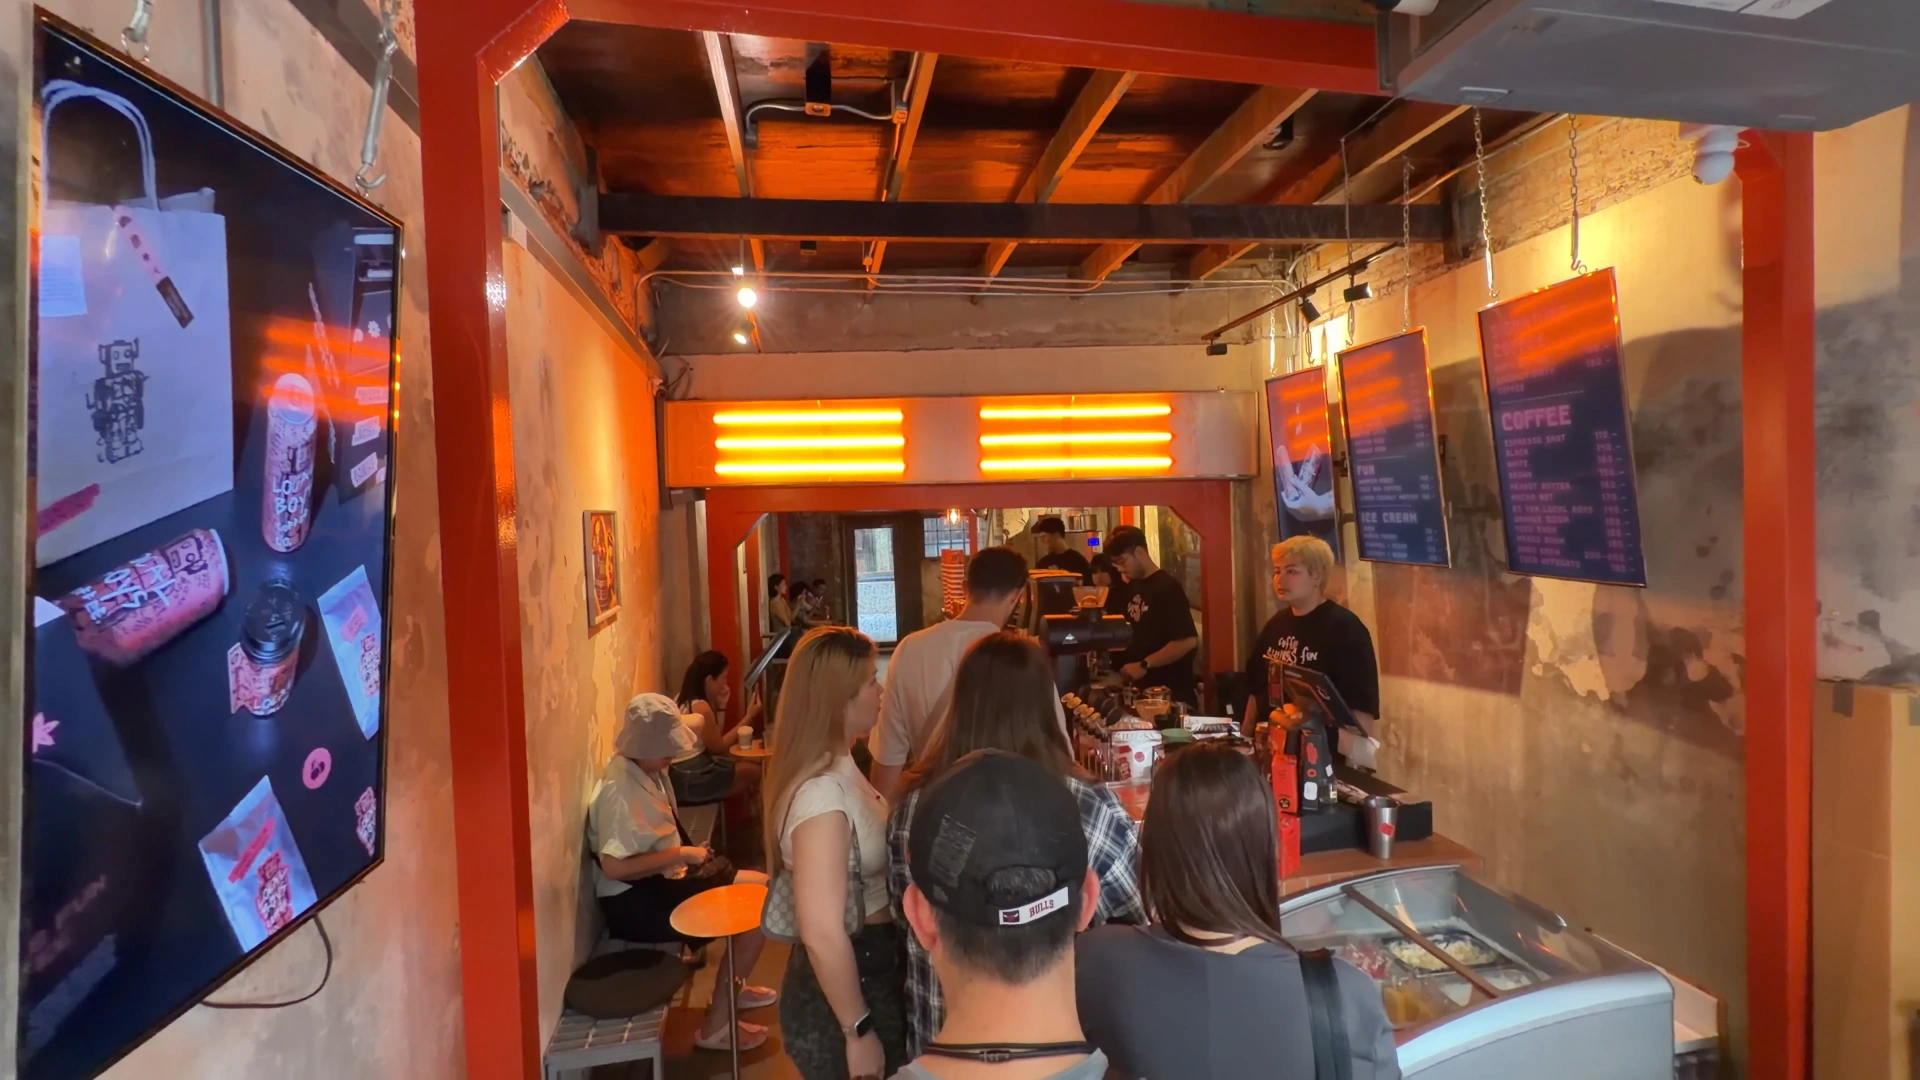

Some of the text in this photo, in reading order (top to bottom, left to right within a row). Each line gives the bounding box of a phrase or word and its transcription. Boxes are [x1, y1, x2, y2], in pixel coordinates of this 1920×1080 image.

[1502, 404, 1572, 431] COFFEE
[1356, 464, 1376, 476] FUN
[1361, 511, 1418, 524] ICE CREAM
[1028, 899, 1055, 918] BULLS
